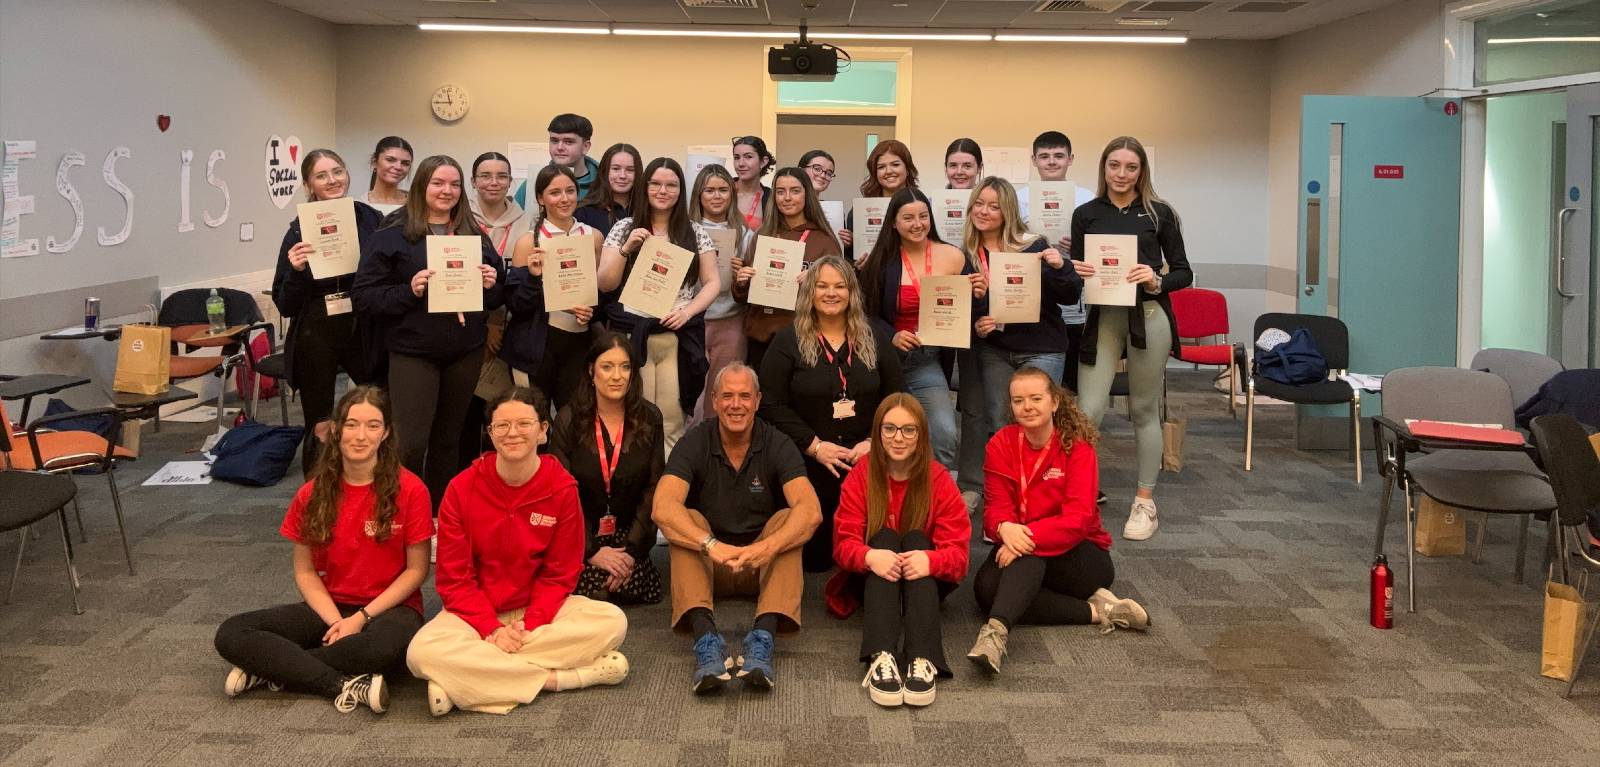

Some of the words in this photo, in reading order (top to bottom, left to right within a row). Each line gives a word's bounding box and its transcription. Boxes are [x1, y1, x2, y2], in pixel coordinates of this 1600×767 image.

[270, 140, 280, 165] I
[269, 168, 297, 186] SOCIAL
[177, 148, 231, 233] IS
[273, 185, 294, 197] WORK
